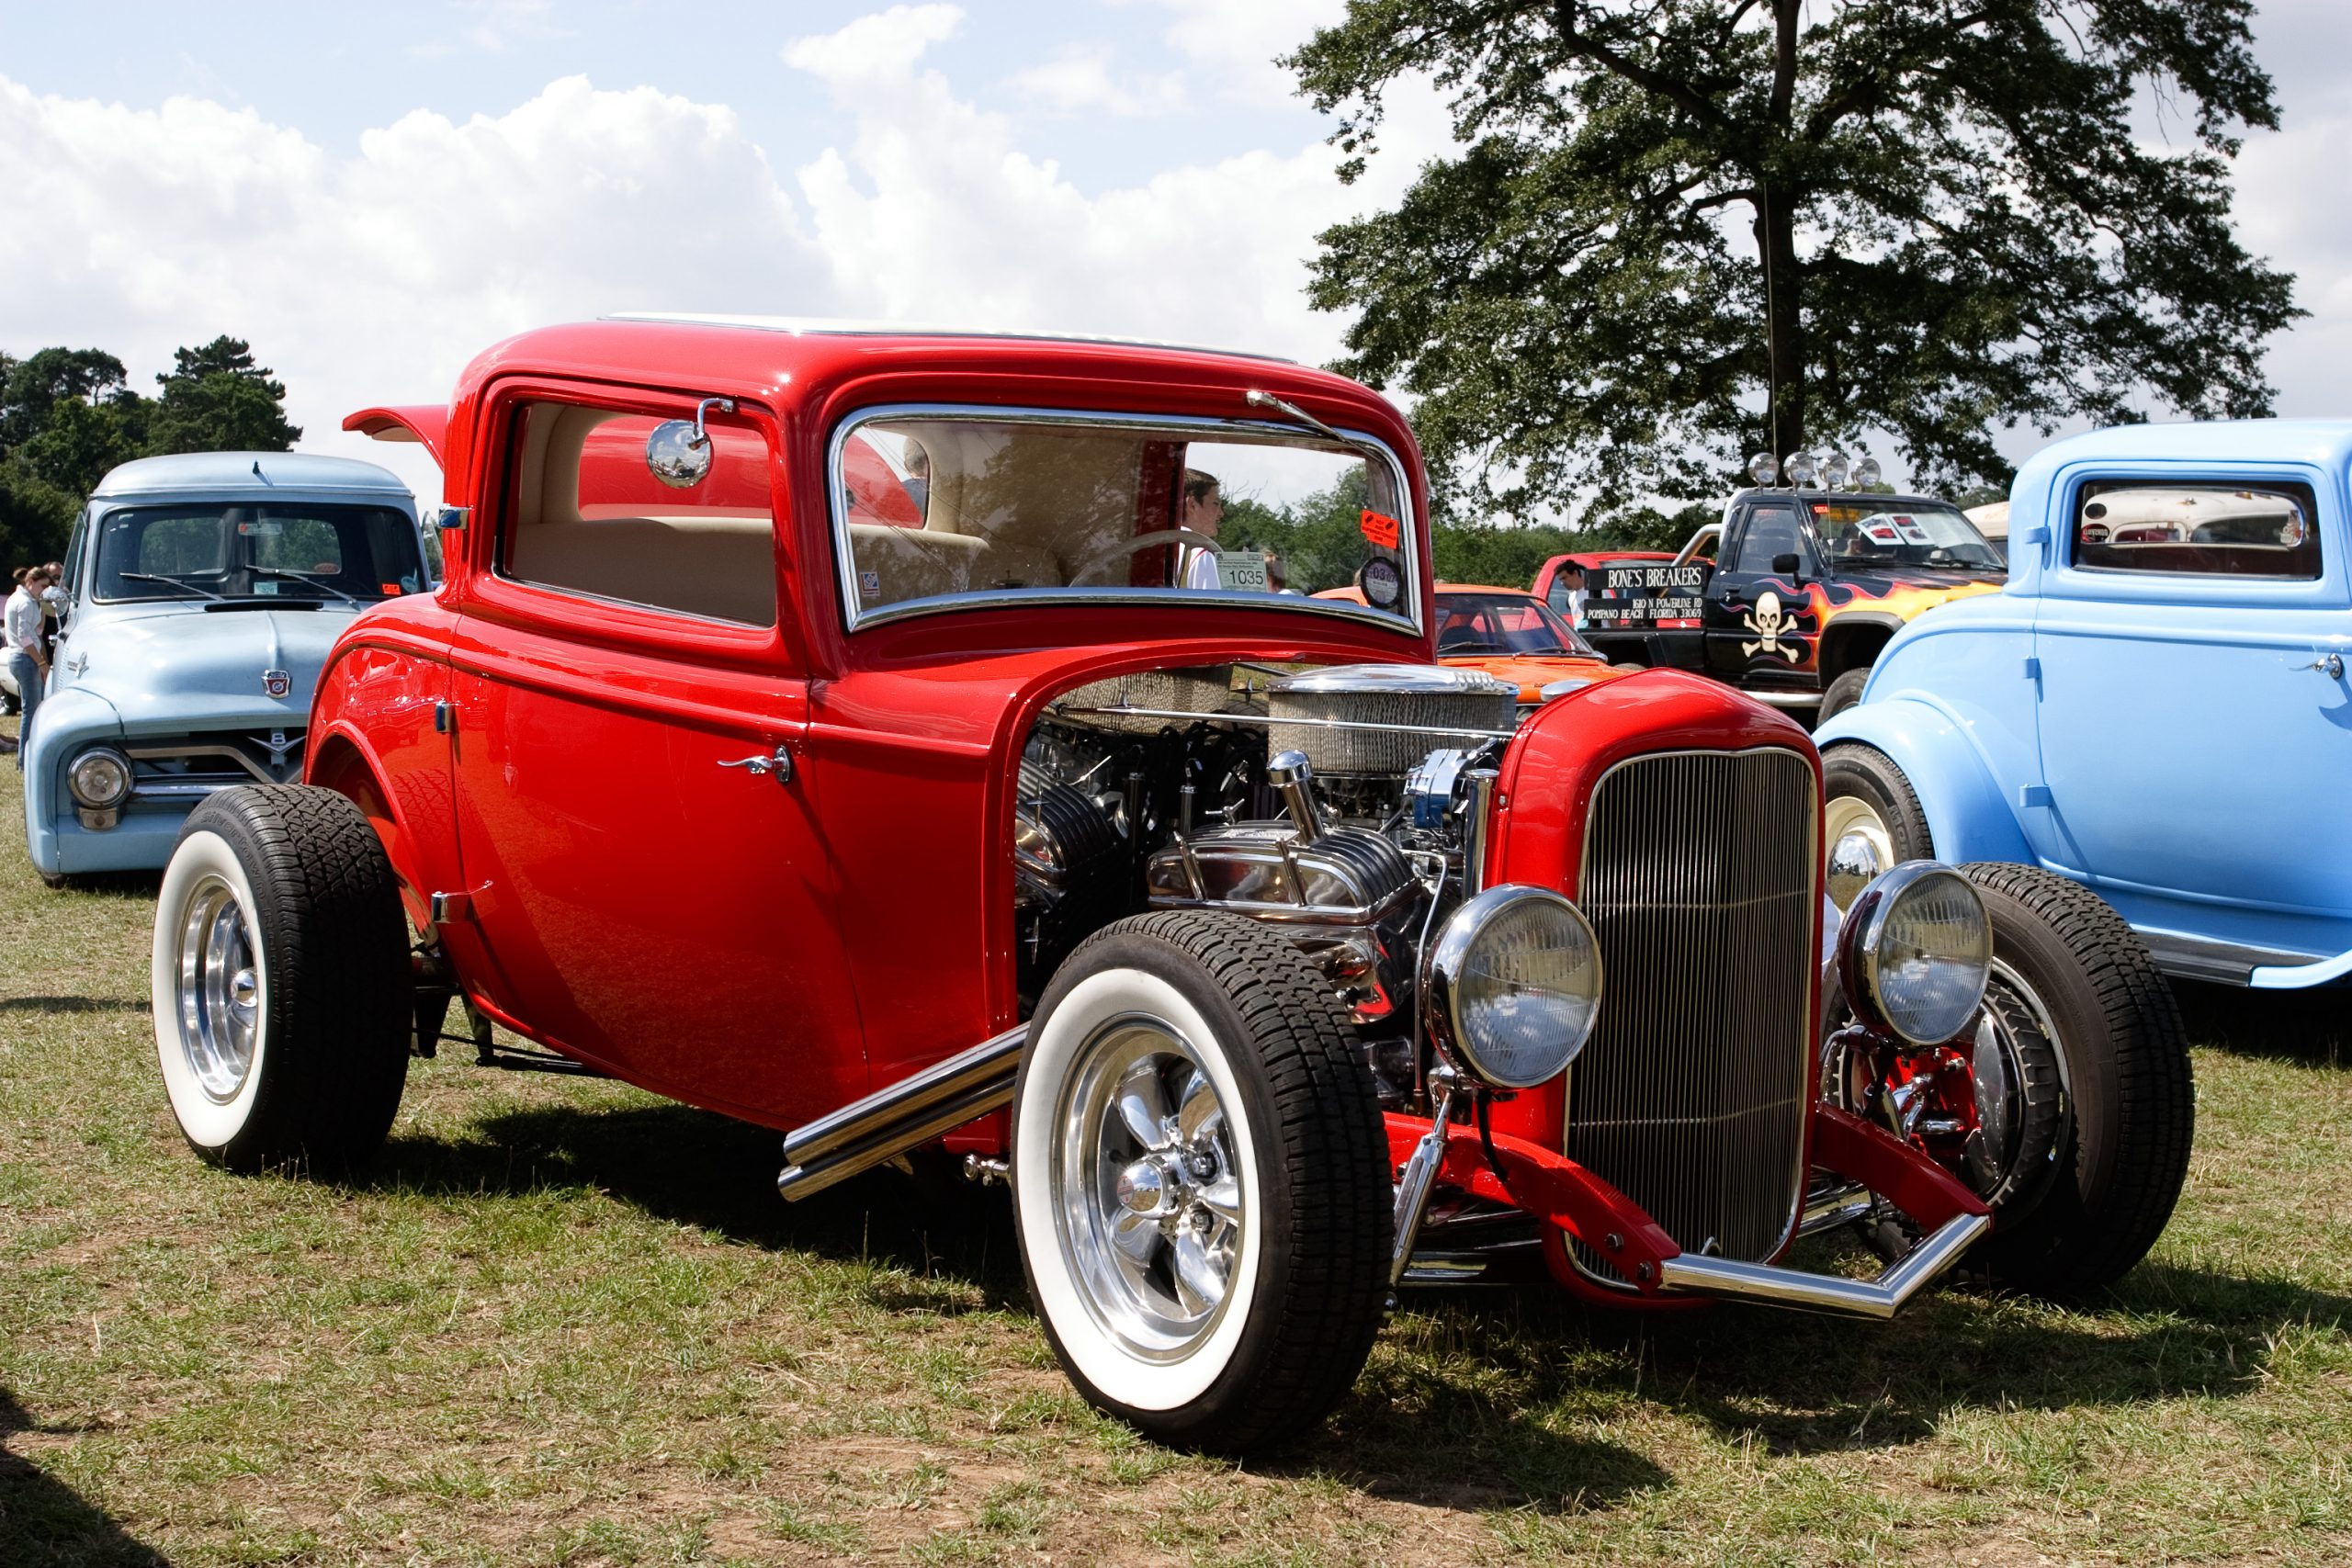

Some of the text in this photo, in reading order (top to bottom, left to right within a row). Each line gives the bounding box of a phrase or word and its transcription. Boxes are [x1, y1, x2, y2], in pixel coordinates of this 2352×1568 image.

[1229, 570, 1264, 585] 1035
[1608, 567, 1702, 588] BONE'S BREAKERS
[1648, 598, 1654, 608] N
[1657, 598, 1691, 608] POWERLINE
[1694, 597, 1702, 608] RD
[1587, 608, 1702, 619] POMPANO BEACH FLORIDA 33069
